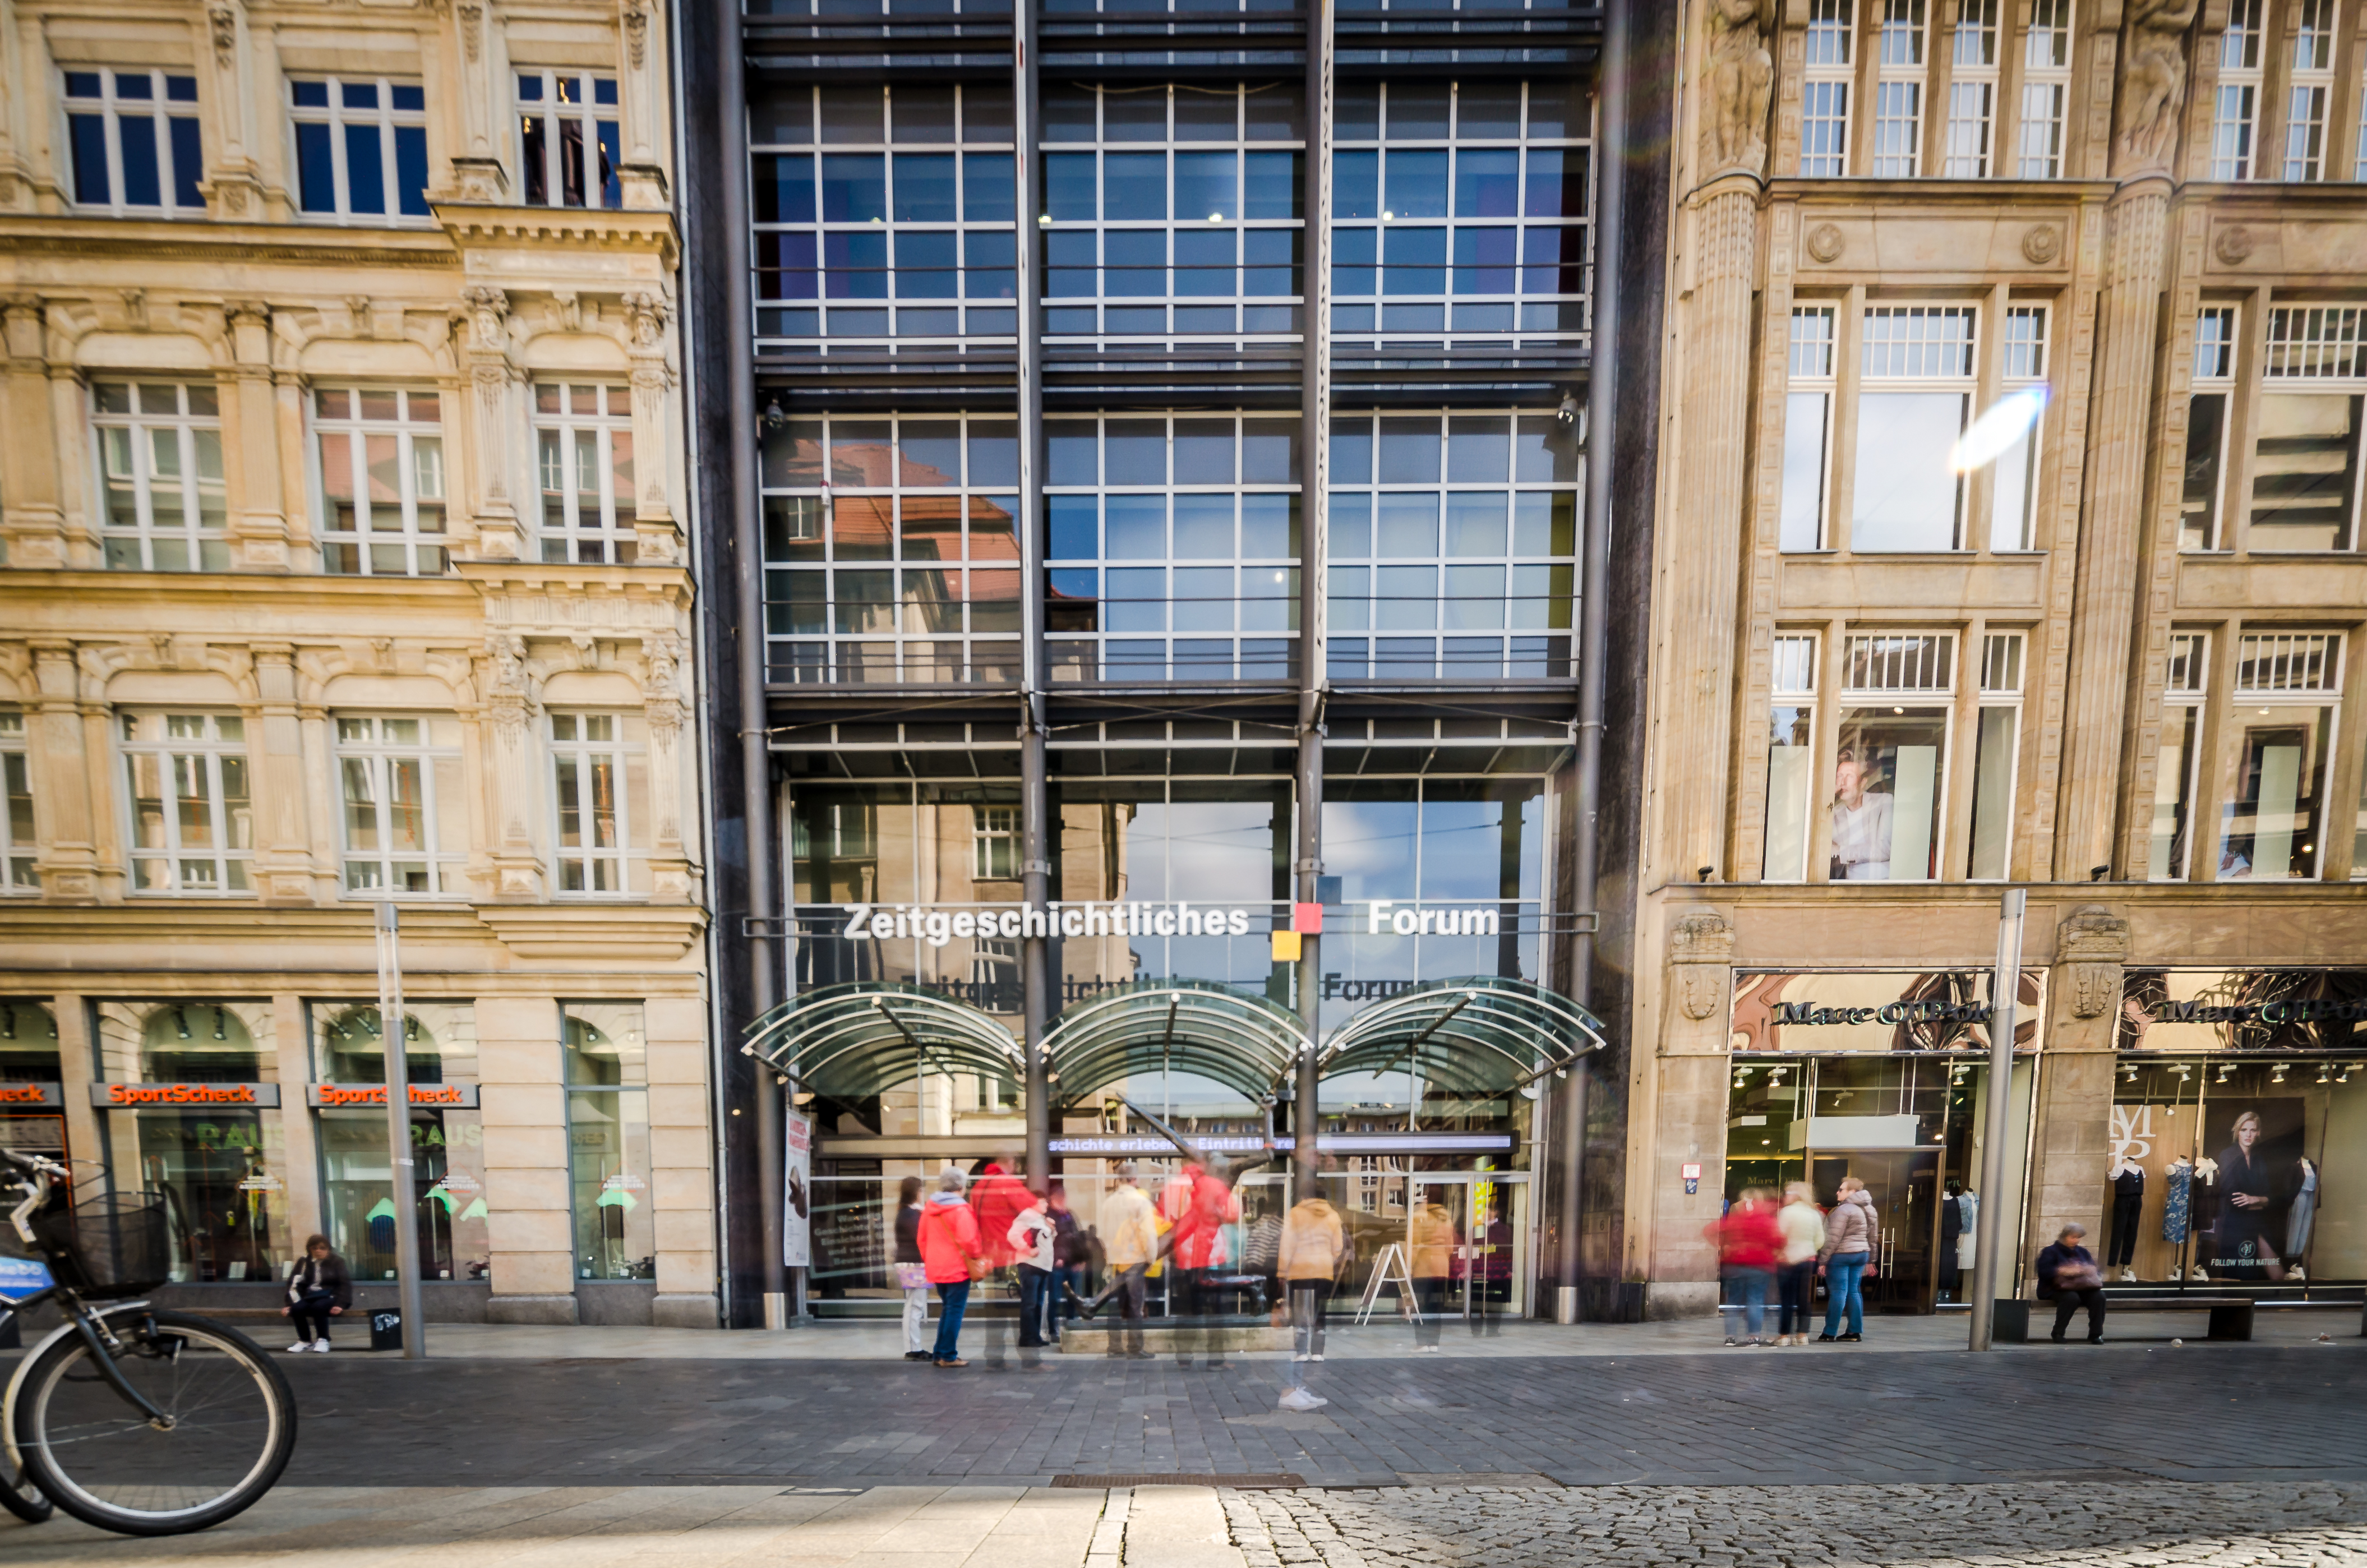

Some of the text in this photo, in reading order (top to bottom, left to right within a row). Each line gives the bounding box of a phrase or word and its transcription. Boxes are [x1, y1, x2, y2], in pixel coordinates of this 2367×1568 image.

[843, 900, 1499, 947] Zeitgeschichtliches Forum
[1769, 1001, 1876, 1026] Marc
[2156, 1000, 2262, 1023] Marc
[109, 1084, 256, 1105] SportScheck
[1197, 1136, 1261, 1150] Eintritt
